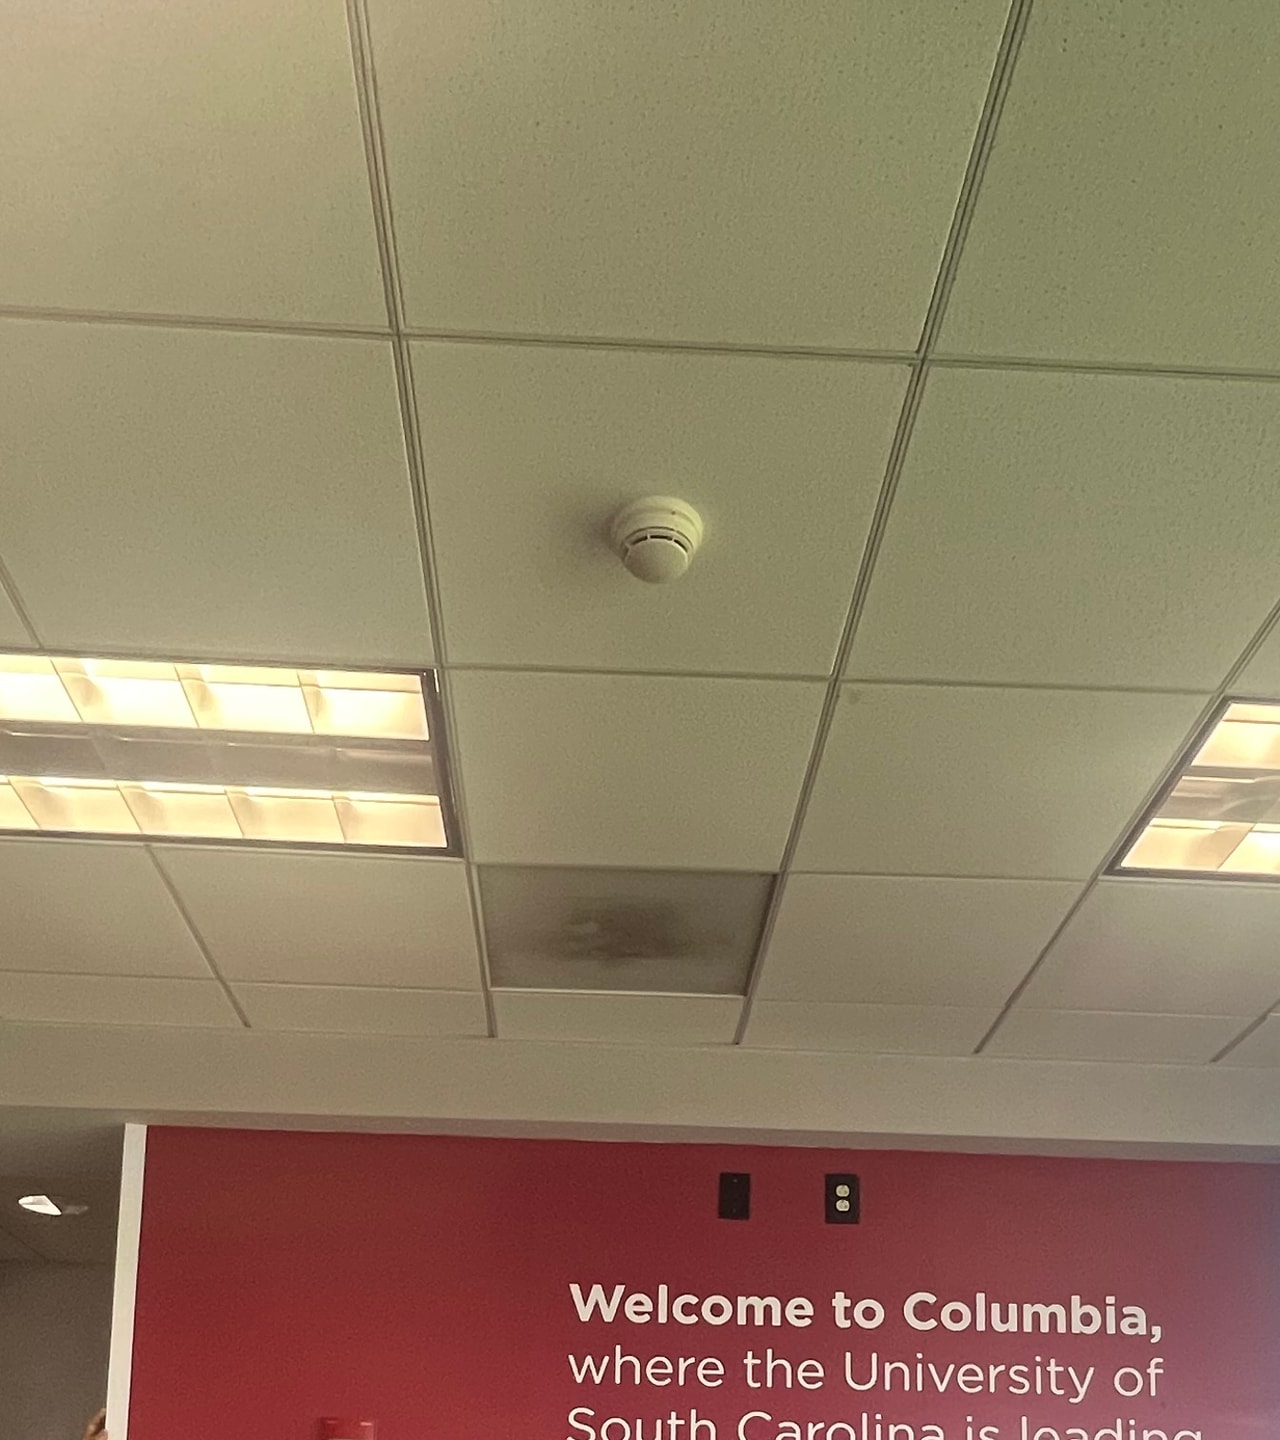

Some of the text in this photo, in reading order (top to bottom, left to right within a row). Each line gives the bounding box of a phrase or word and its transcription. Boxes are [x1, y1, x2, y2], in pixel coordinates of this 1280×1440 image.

[569, 1283, 1162, 1343] Welcome to Columbia,
[568, 1345, 1164, 1404] where the University of
